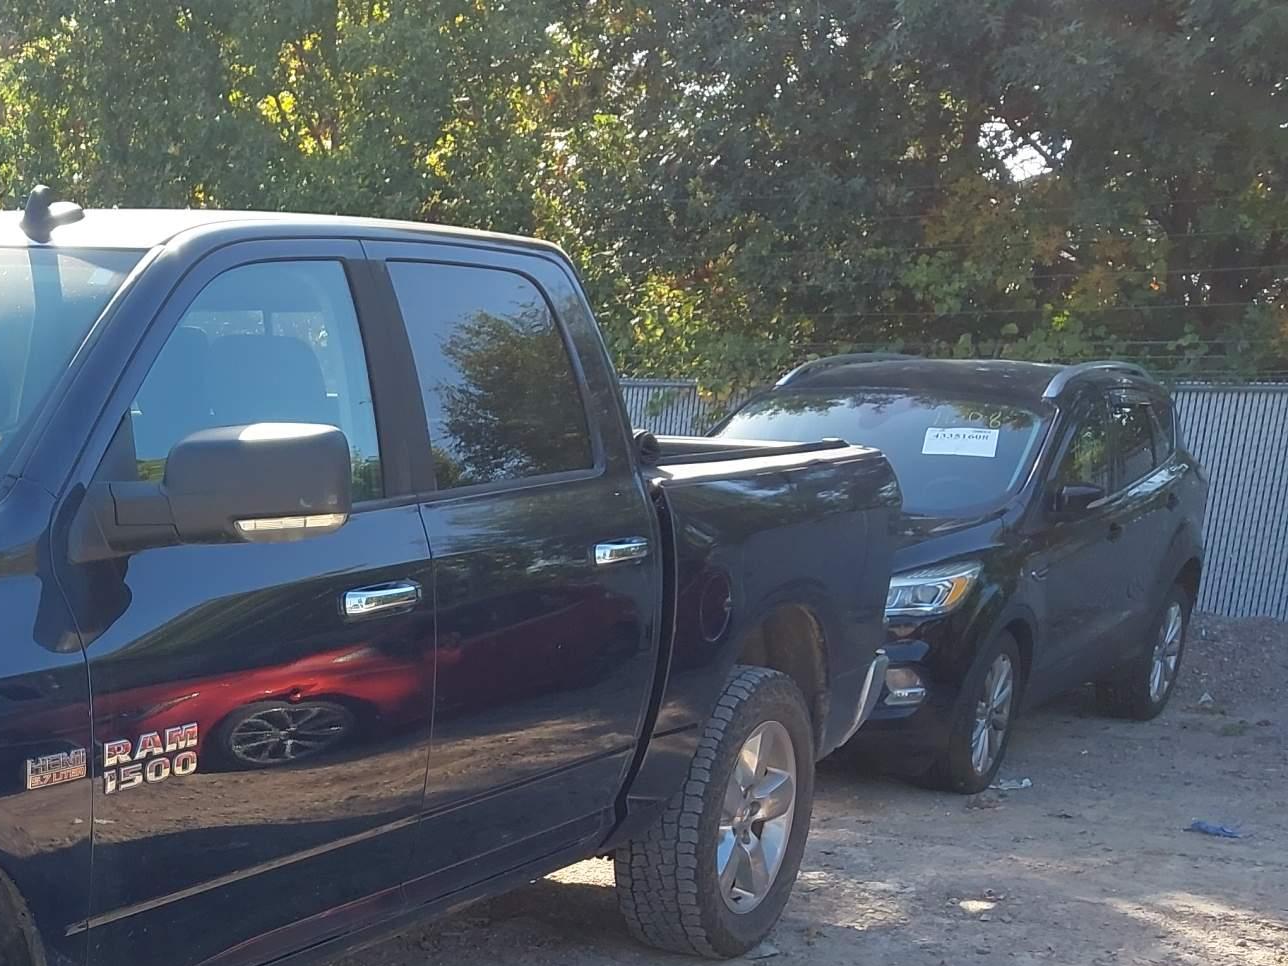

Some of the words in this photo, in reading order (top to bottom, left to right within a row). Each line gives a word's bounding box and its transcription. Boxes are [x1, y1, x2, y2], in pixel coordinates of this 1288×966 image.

[26, 747, 87, 776] HEMI
[103, 722, 199, 767] RAM
[103, 750, 198, 795] 1500
